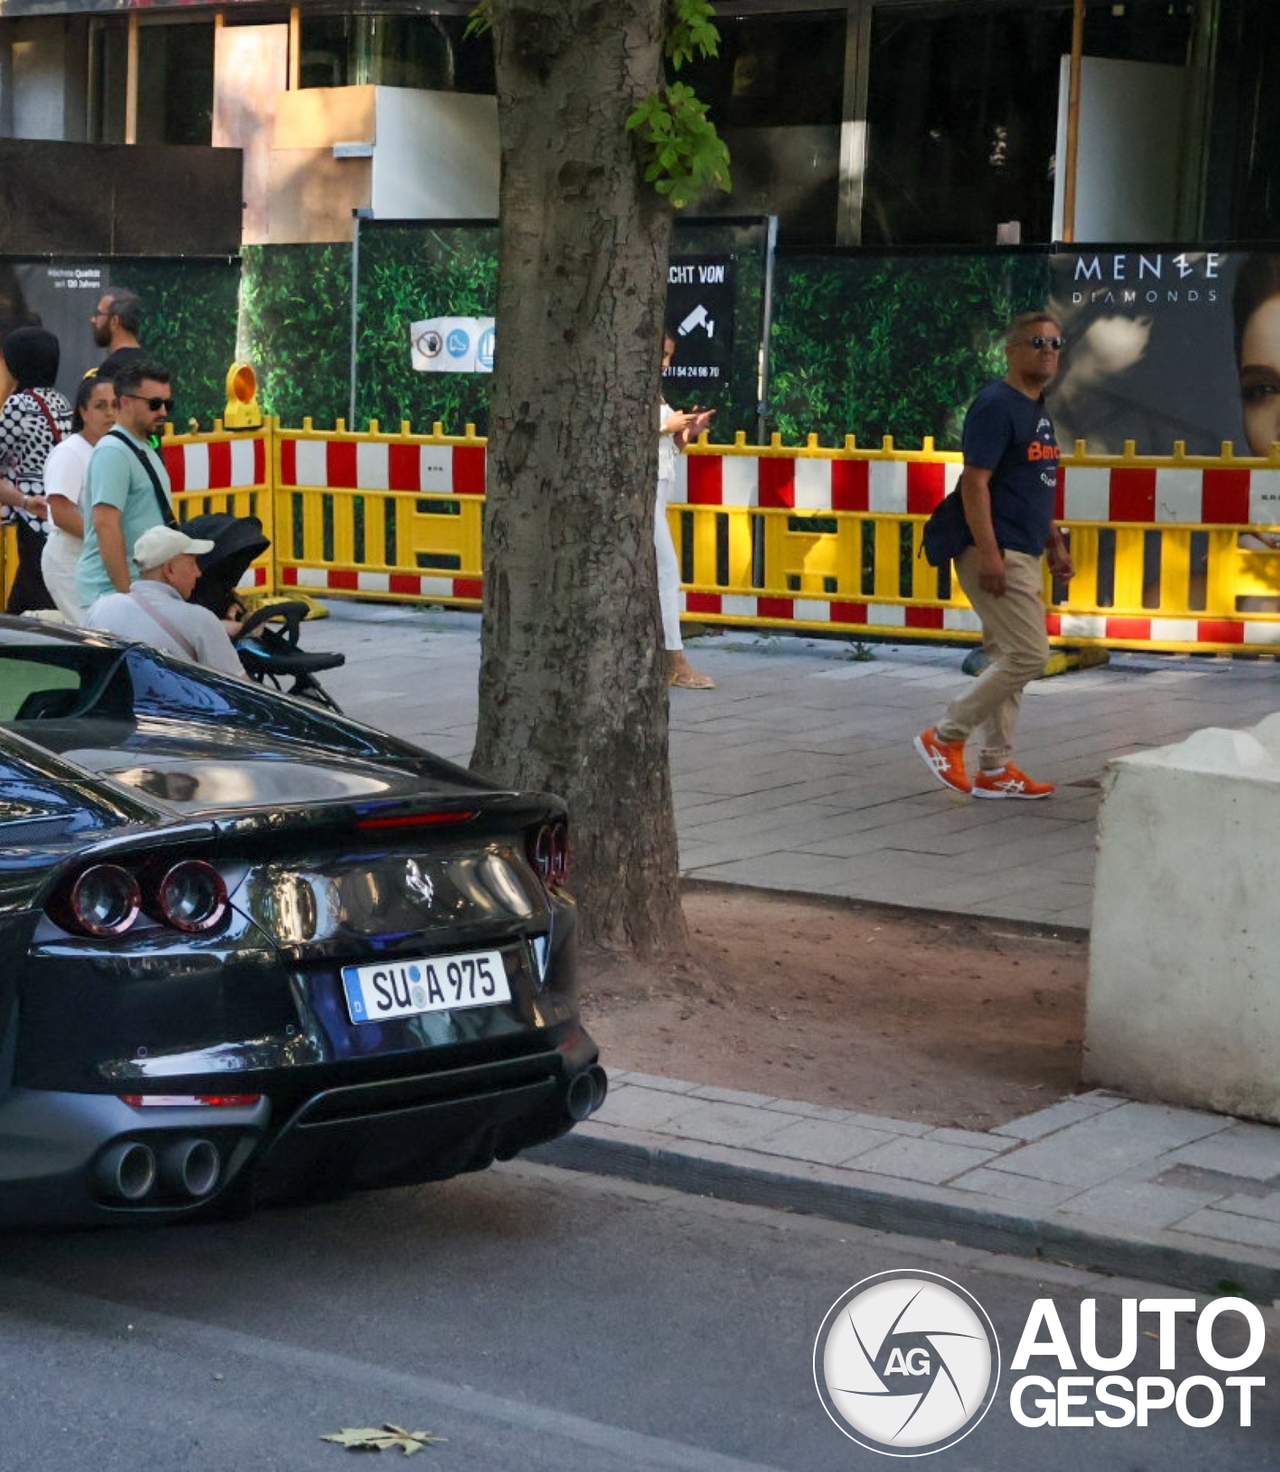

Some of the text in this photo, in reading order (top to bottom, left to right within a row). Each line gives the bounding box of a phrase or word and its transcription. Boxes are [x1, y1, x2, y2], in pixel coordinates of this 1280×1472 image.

[667, 265, 725, 283] CHT VON
[1072, 290, 1217, 303] DIAMONDS
[372, 968, 412, 1011] SU
[426, 964, 445, 1004] A
[447, 957, 496, 1001] 975
